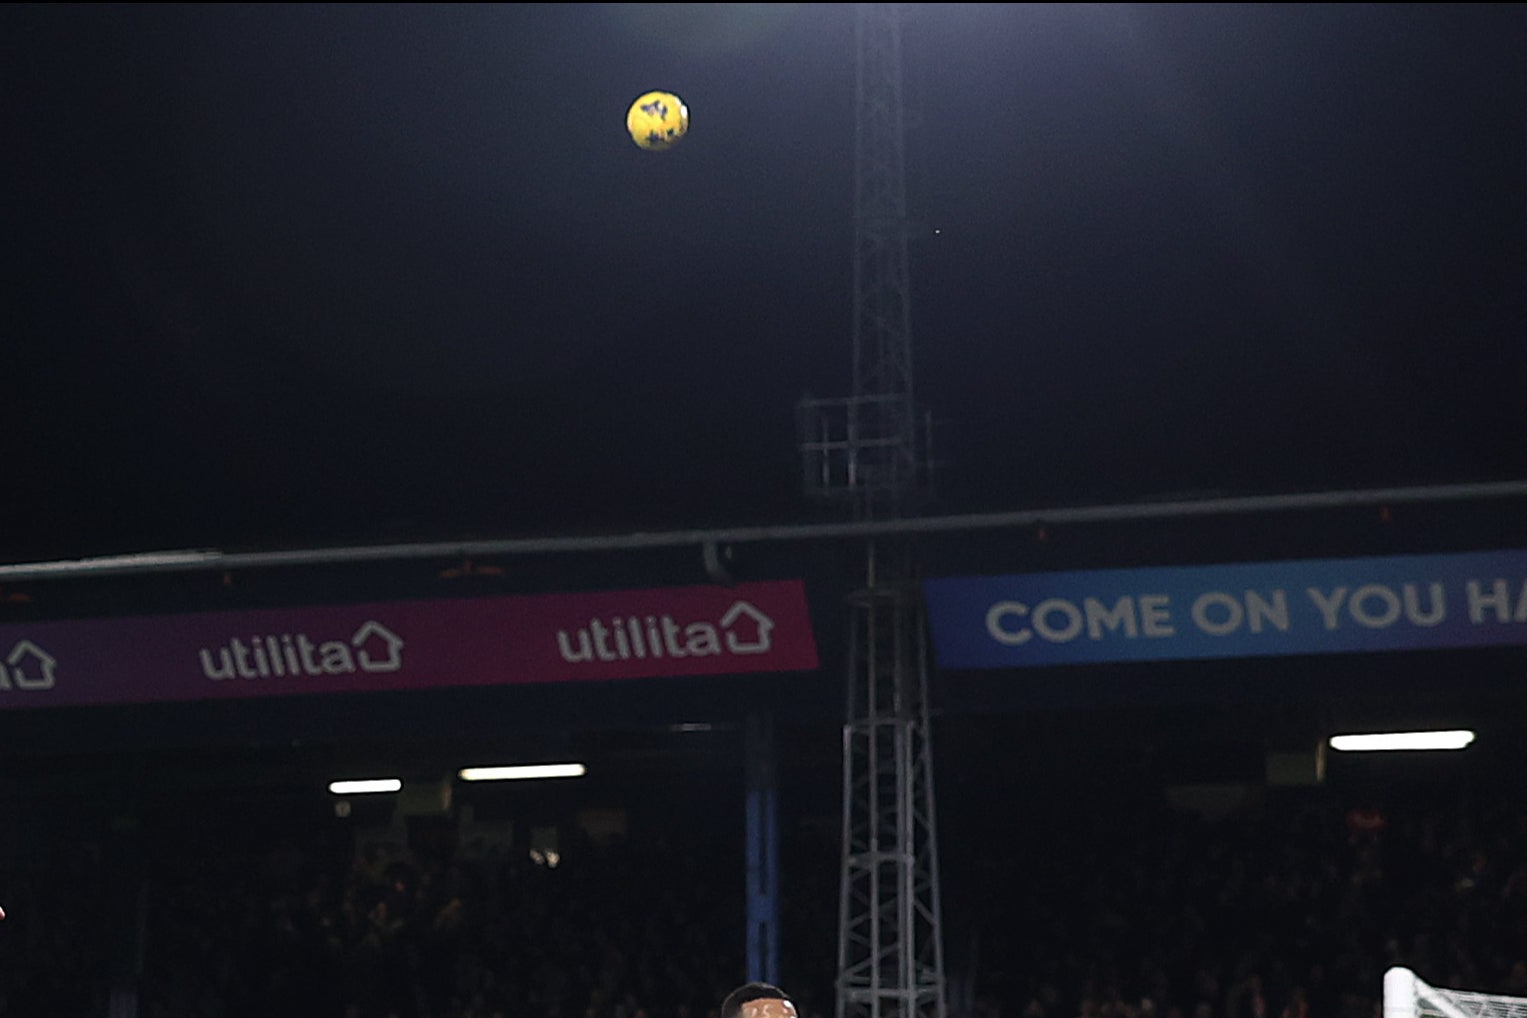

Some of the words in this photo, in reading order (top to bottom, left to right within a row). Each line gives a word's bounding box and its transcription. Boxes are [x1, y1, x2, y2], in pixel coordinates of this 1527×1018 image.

[985, 593, 1173, 645] COME
[1191, 588, 1291, 635] ON
[1306, 582, 1446, 631] YOU
[199, 635, 356, 681] utilita
[557, 616, 722, 662] utilita
